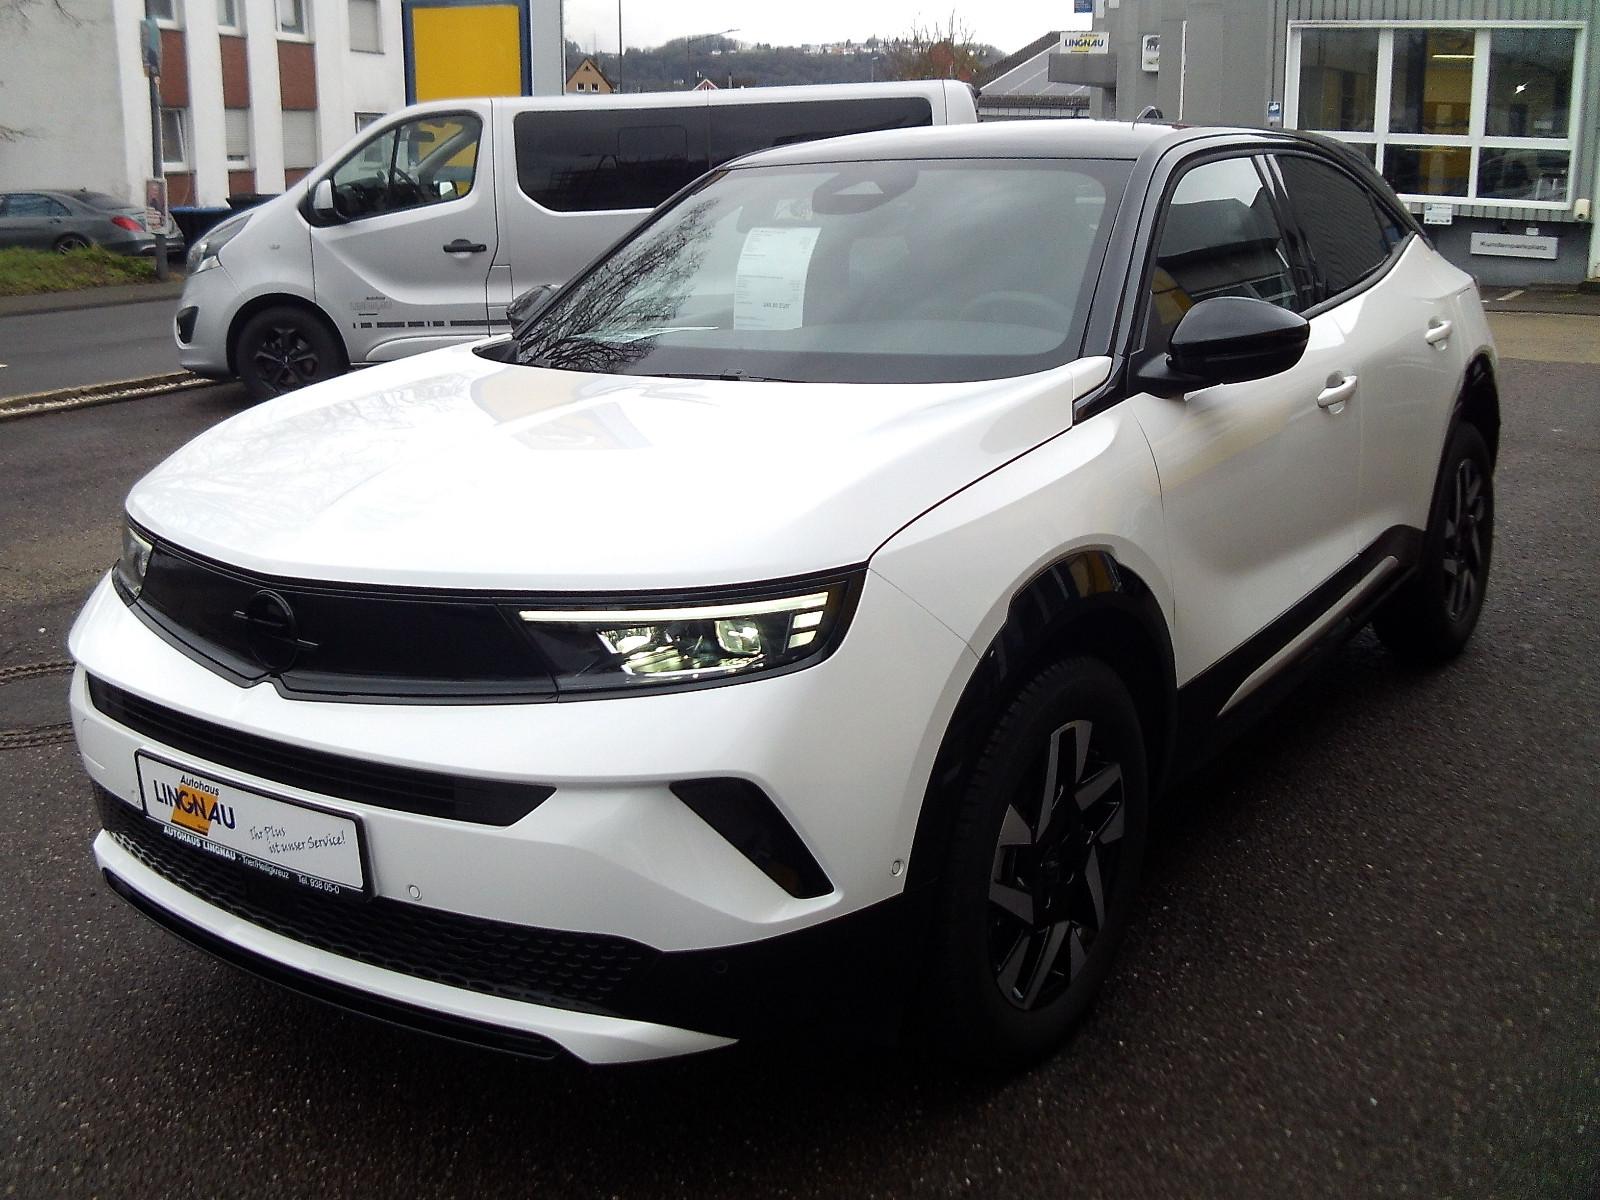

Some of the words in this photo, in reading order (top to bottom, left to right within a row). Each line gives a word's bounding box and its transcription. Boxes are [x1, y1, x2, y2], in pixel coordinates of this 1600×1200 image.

[1064, 39, 1104, 47] LINGNAU
[180, 774, 220, 797] Autohaus
[153, 779, 236, 830] LINGNAU
[250, 826, 263, 840] Ihr
[264, 825, 286, 841] Plus
[268, 840, 281, 854] ist
[281, 840, 306, 853] unser
[307, 830, 346, 849] Service!
[163, 825, 201, 847] AUTOHAUS
[202, 840, 236, 861] LINGNAU
[297, 873, 308, 886] Tel.
[309, 877, 323, 890] 938
[324, 881, 340, 895] 05-0
